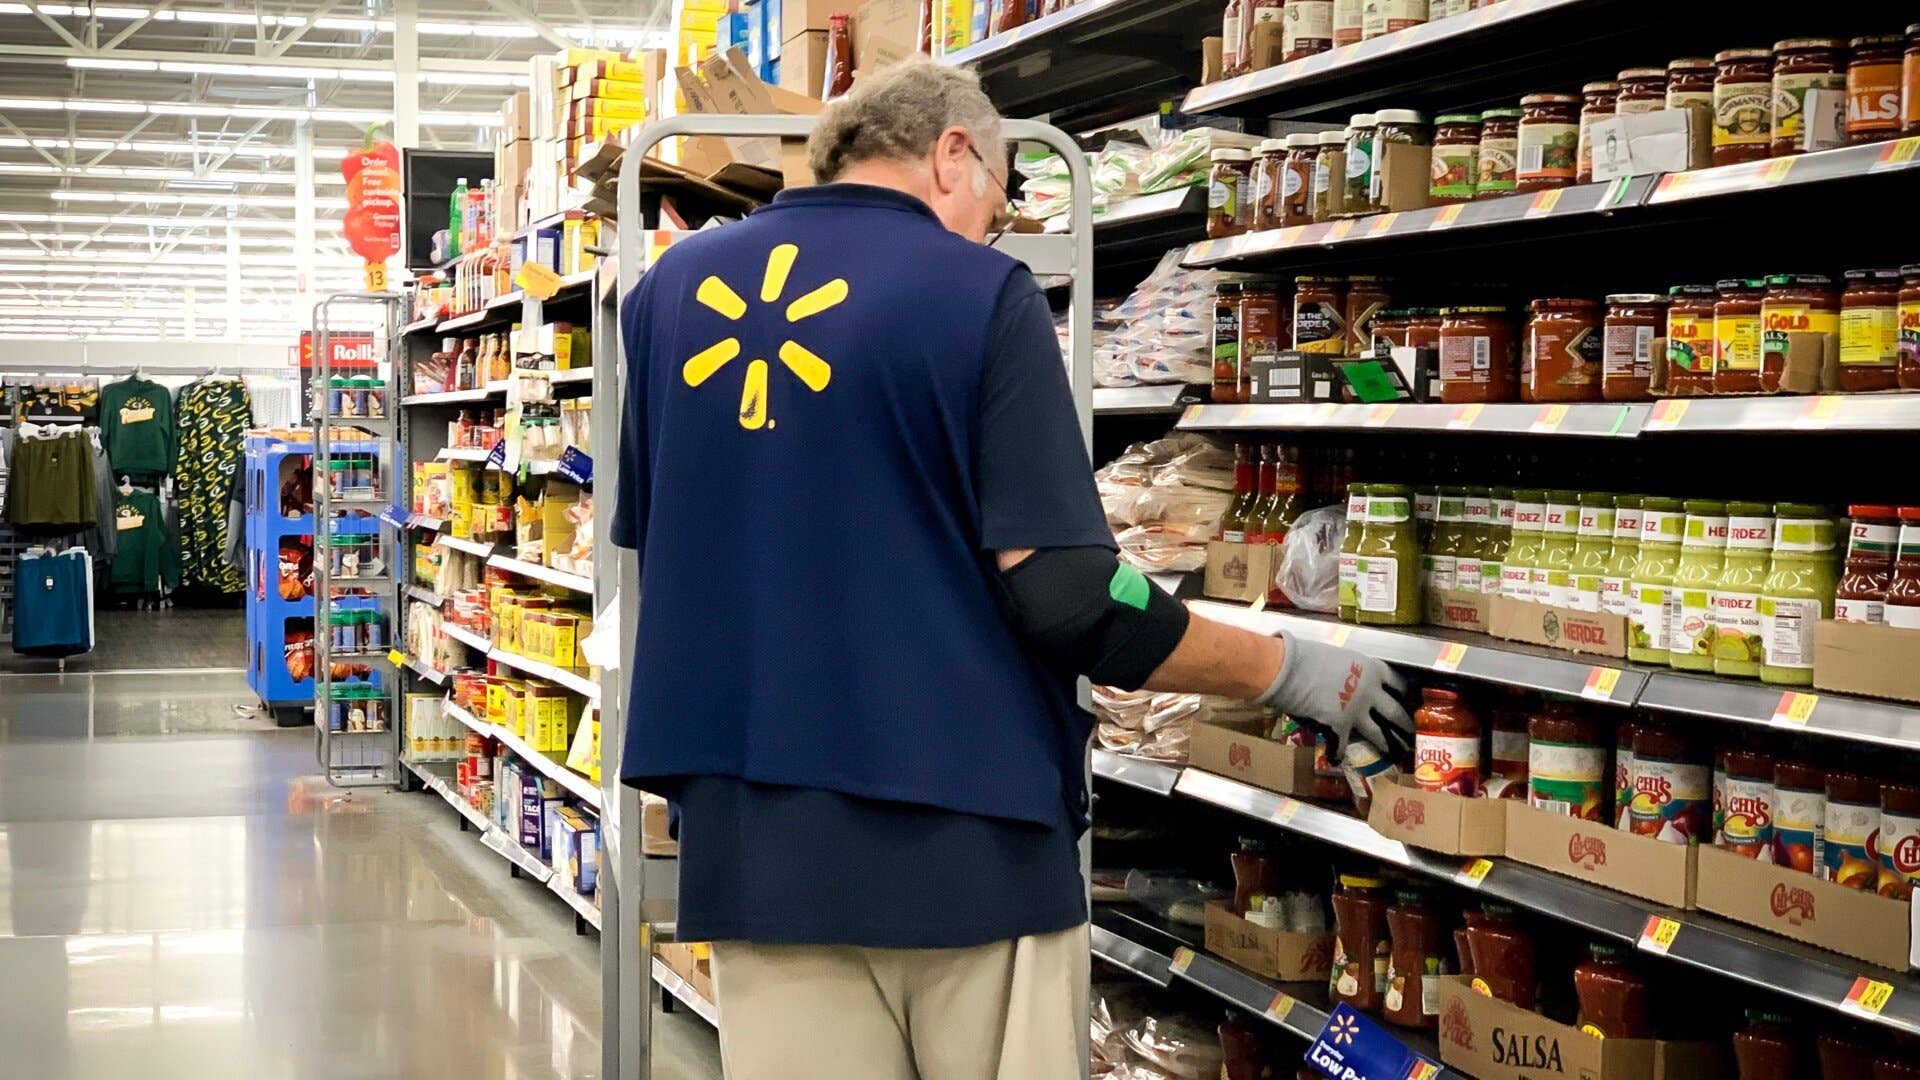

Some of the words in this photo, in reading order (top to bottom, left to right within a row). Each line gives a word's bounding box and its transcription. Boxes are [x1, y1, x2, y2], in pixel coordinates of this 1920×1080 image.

[361, 157, 388, 167] Order
[369, 270, 384, 287] 13
[1769, 313, 1809, 330] GOLD
[1562, 621, 1607, 646] HERDEZ
[1492, 1026, 1565, 1073] SALSA
[1310, 1046, 1344, 1077] Low
